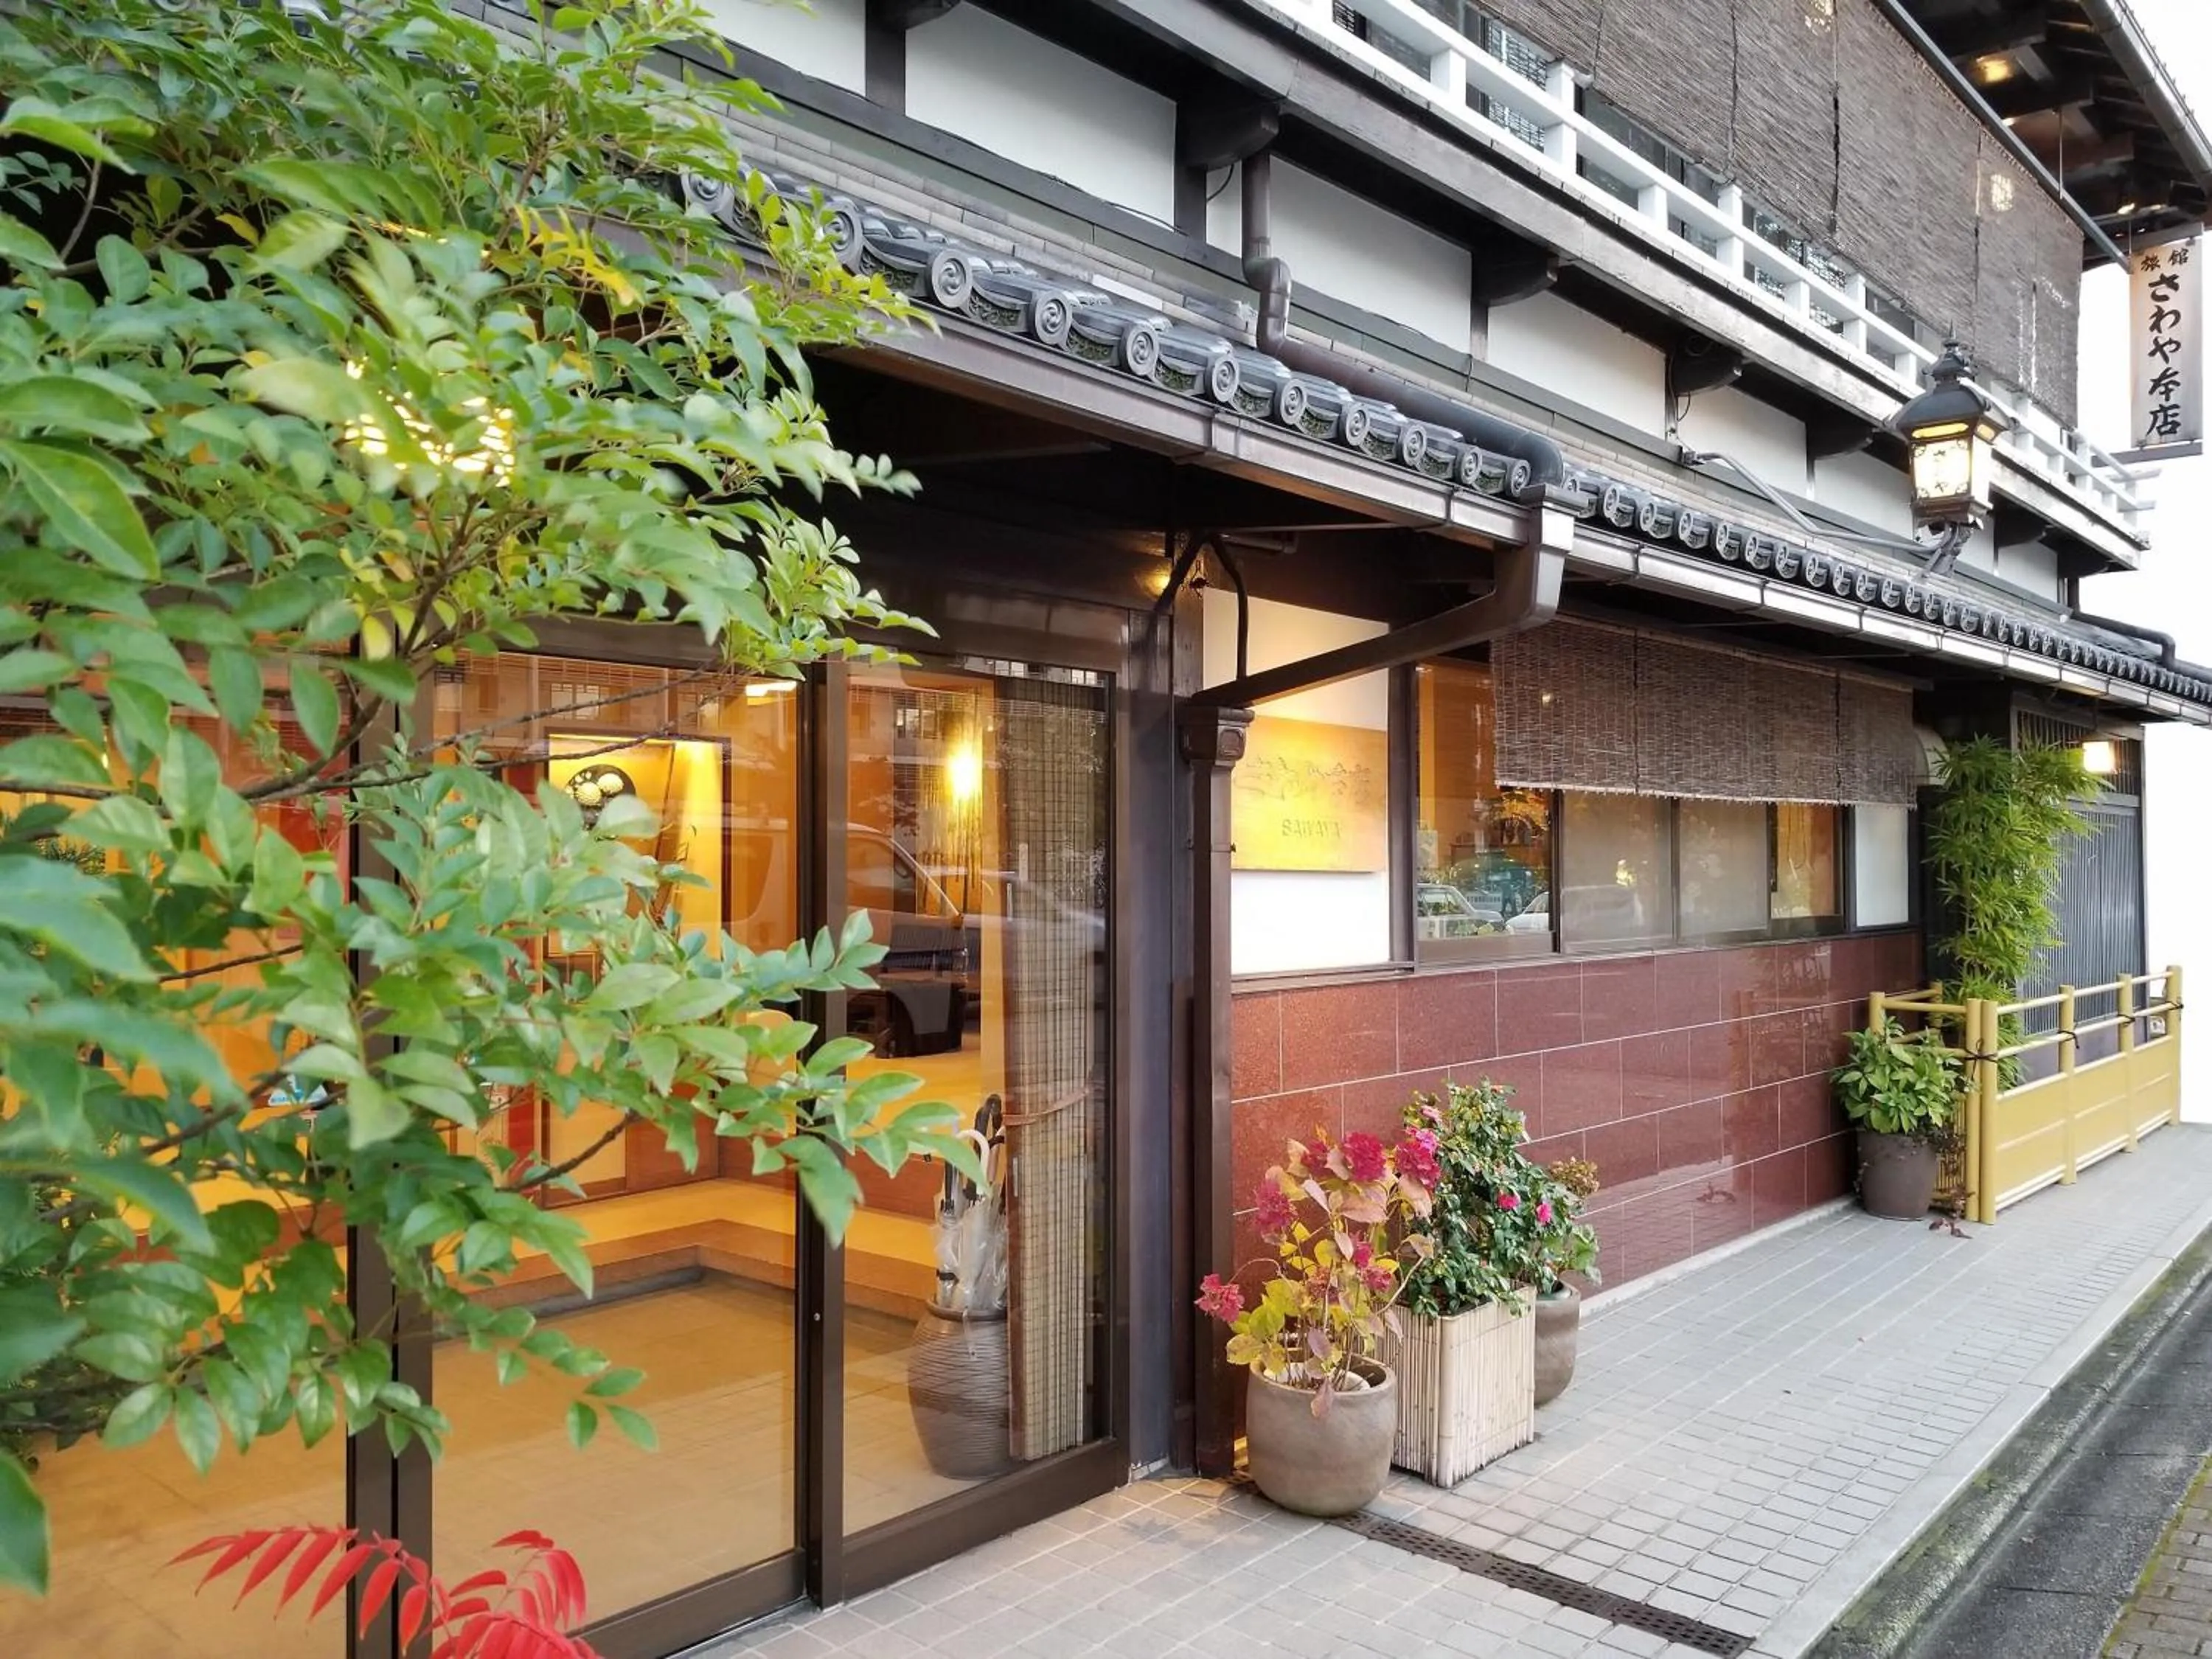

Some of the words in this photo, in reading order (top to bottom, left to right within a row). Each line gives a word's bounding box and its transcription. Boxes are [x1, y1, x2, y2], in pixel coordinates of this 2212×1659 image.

[2140, 248, 2188, 272] 旅館
[2146, 274, 2181, 437] さわや本店
